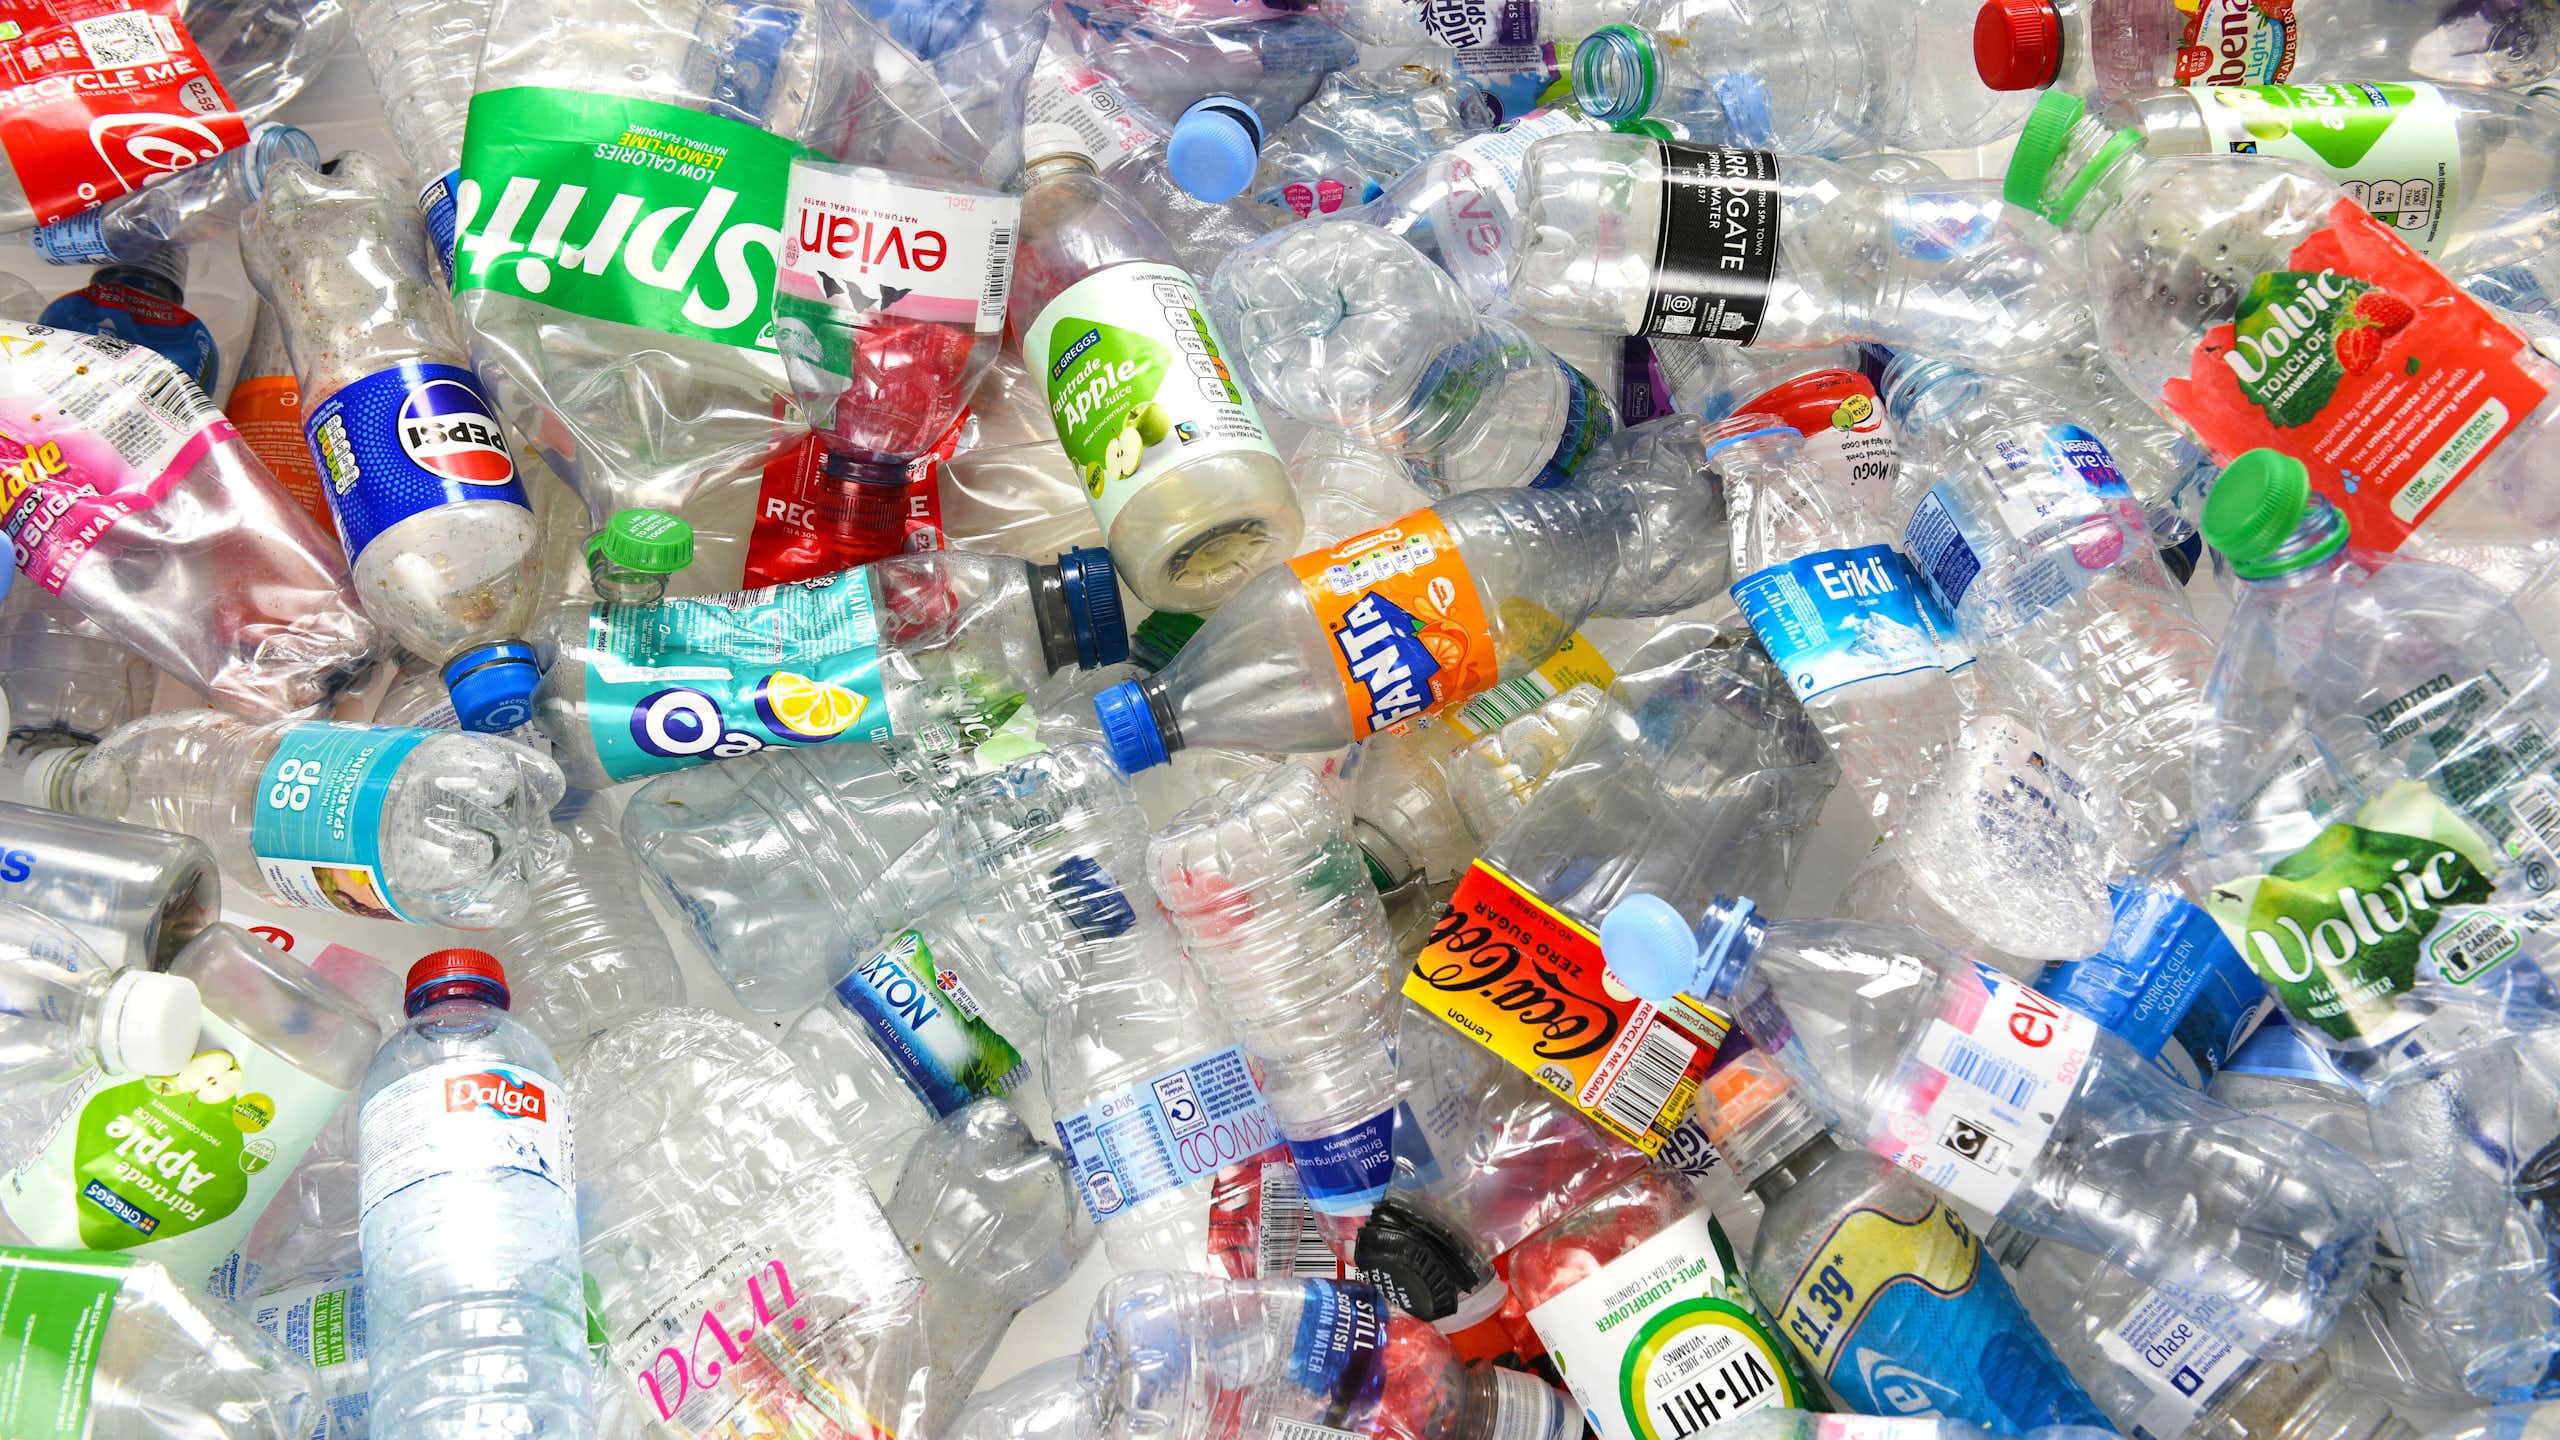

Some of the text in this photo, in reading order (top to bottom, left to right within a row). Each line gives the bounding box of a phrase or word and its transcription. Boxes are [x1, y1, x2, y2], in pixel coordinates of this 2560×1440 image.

[2245, 31, 2268, 78] Light
[0, 58, 198, 109] RECYCLE ME
[617, 131, 725, 170] LEMON-LIME
[628, 124, 729, 156] NATURAL FLAVOURS
[594, 143, 716, 184] LOW CALORIES
[832, 202, 869, 216] MINERAL
[1698, 185, 1706, 203] 1571
[1709, 188, 1721, 229] WATER
[873, 209, 919, 225] NATURAL
[1758, 210, 1767, 225] SPA
[800, 208, 948, 274] evian
[1754, 227, 1765, 256] TOWN
[2217, 257, 2356, 389] Volvic
[1060, 331, 1098, 369] GREGGS
[2254, 326, 2331, 403] TOUCH OF
[1052, 357, 1101, 418] Fairtrade
[1064, 359, 1137, 435] Apple
[1104, 384, 1133, 410] Juice
[2268, 352, 2331, 411] STRAWBERRY
[406, 421, 505, 455] PEPSI
[2405, 406, 2494, 500] LOW NO ARTIFICIAL
[22, 482, 99, 550] SUGAR
[45, 500, 131, 589] LEMONADE
[1813, 556, 1896, 601] Erikli
[1370, 595, 1421, 733] FANTA
[329, 743, 375, 843] SPARKLING
[2251, 850, 2457, 984] Volvic
[2462, 920, 2507, 954] CARBON
[1470, 900, 1585, 980] ZERO SUGAR
[2470, 932, 2516, 966] NEUTRAL
[955, 987, 980, 1013] BRITISH
[2129, 969, 2176, 1023] CARRICK
[2163, 937, 2196, 974] GLEN
[2154, 964, 2198, 1015] SOURCE
[954, 996, 974, 1017] PURE
[1448, 1008, 1494, 1044] Lemon
[2007, 980, 2063, 1048] evi
[879, 1018, 898, 1043] STILL
[1582, 1002, 1654, 1104] RECYCLE ME AGAIN
[450, 1079, 540, 1115] Dalga
[1603, 1068, 1631, 1106] 669794
[132, 1105, 170, 1135] Juice
[1361, 1125, 1378, 1138] by
[105, 1113, 217, 1195] Apple
[1313, 1137, 1384, 1169] British spring
[1359, 1149, 1391, 1171] Still
[86, 1183, 143, 1225] GREGGS
[114, 1159, 206, 1223] Fairtrade
[1370, 1268, 1382, 1283] TO
[1382, 1270, 1400, 1306] ATTAC
[1675, 1256, 1710, 1285] APPLE
[315, 1308, 331, 1329] YOU
[1399, 1291, 1412, 1310] AM
[1593, 1279, 1675, 1335] ELDERFLOWER
[1330, 1291, 1354, 1353] SCOTTISH
[1350, 1299, 1379, 1353] STILL
[1307, 1327, 1331, 1374] WATER
[1652, 1334, 1734, 1391] WATER JUICE TEA
[1661, 1334, 1706, 1367] VITAMINS
[2141, 1315, 2195, 1374] Chase
